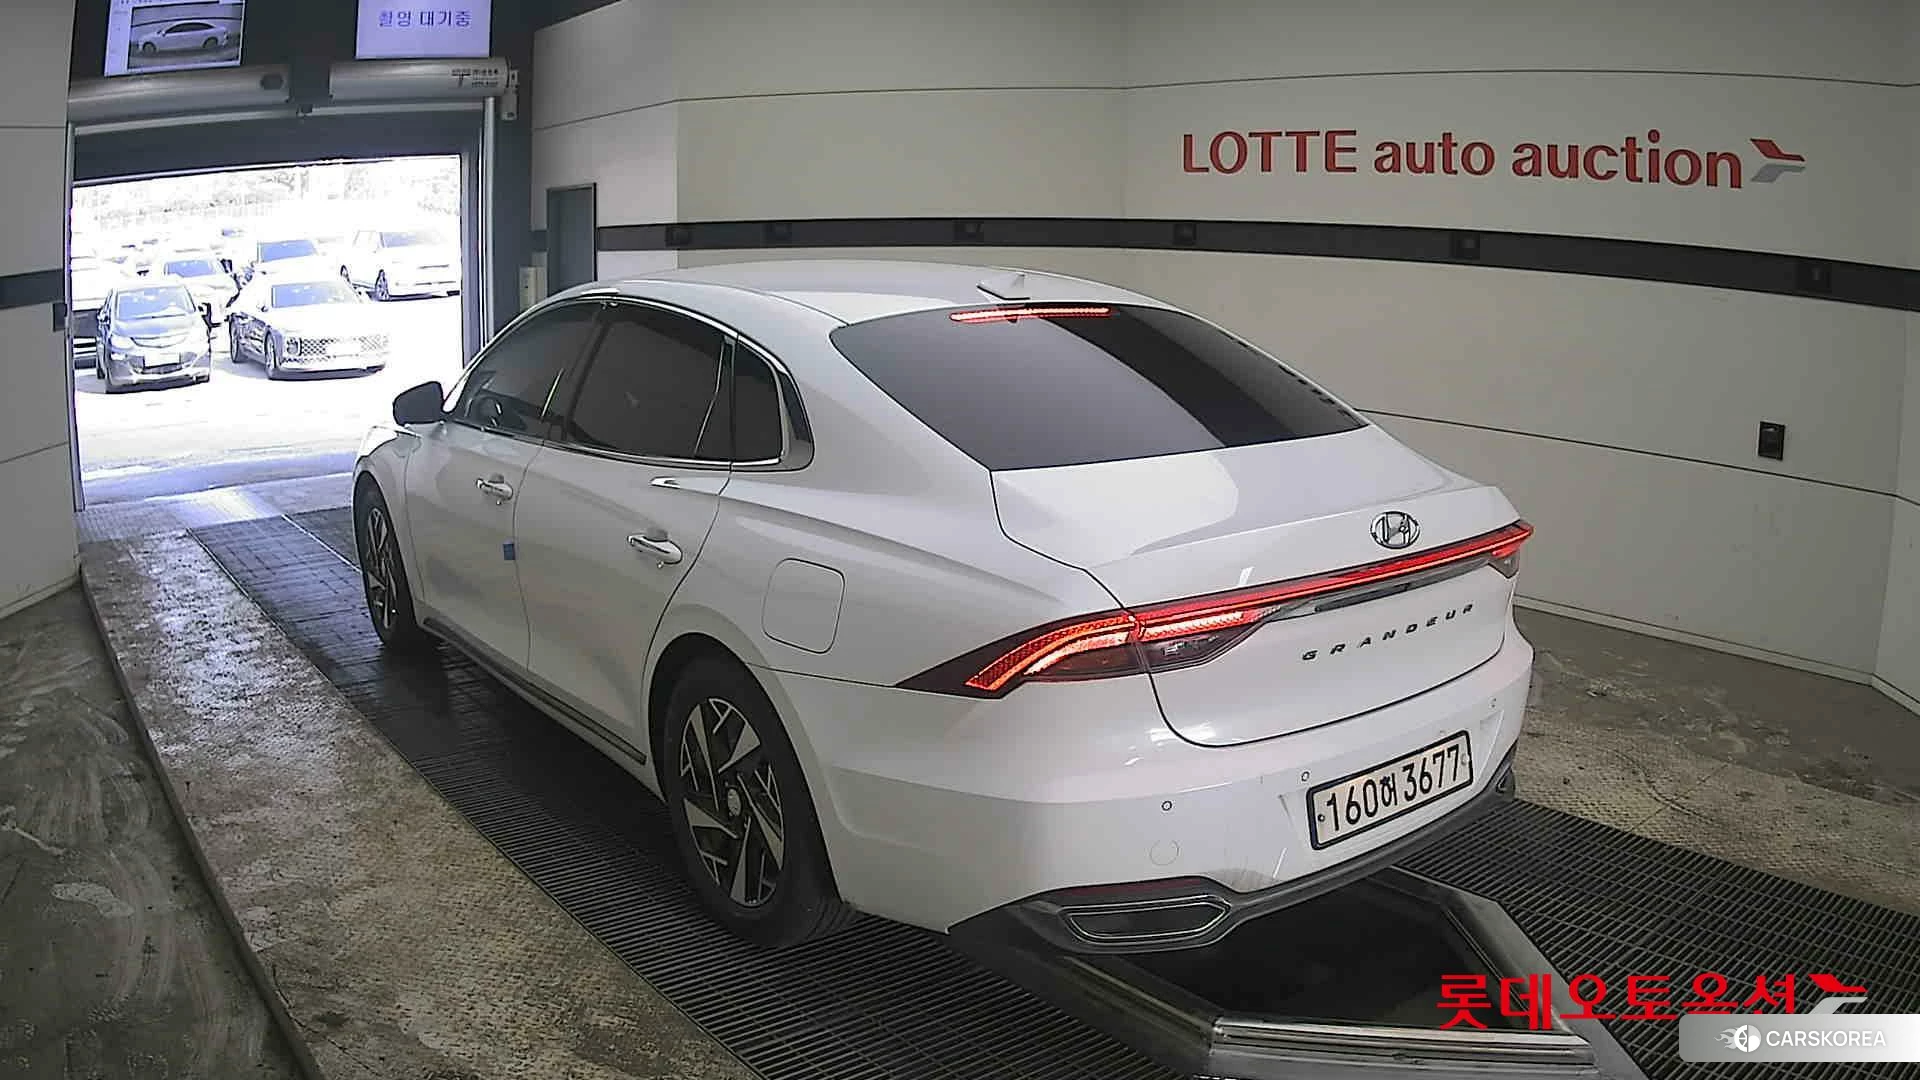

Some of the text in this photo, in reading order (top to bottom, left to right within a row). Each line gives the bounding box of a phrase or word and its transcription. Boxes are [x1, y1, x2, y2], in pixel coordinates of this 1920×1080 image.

[419, 10, 472, 27] 대기중
[1183, 130, 1743, 189] LOTTE auto auction
[1302, 603, 1473, 661] GRANDEUR
